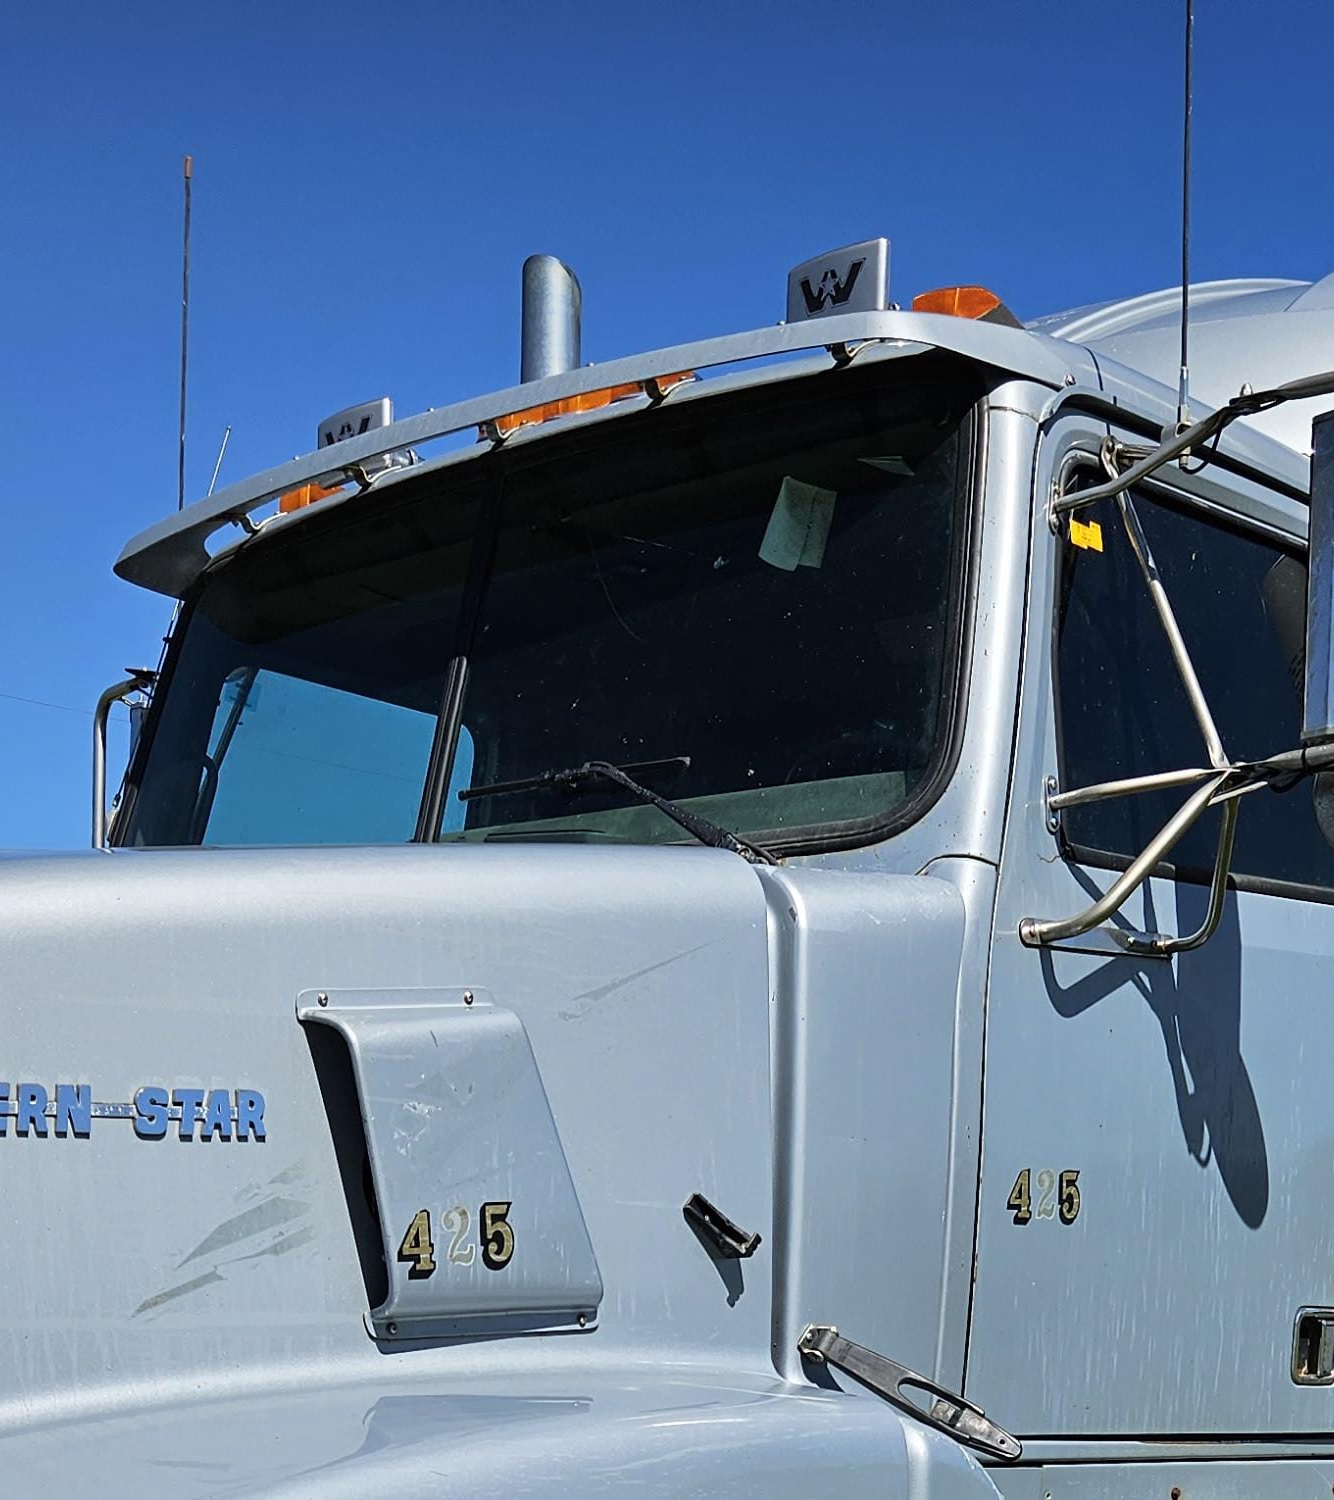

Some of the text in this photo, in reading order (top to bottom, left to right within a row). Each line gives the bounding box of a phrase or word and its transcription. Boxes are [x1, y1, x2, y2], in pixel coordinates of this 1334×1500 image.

[799, 256, 867, 314] W
[134, 1087, 267, 1142] STAR
[1006, 1167, 1081, 1226] 425
[397, 1201, 515, 1280] 425
